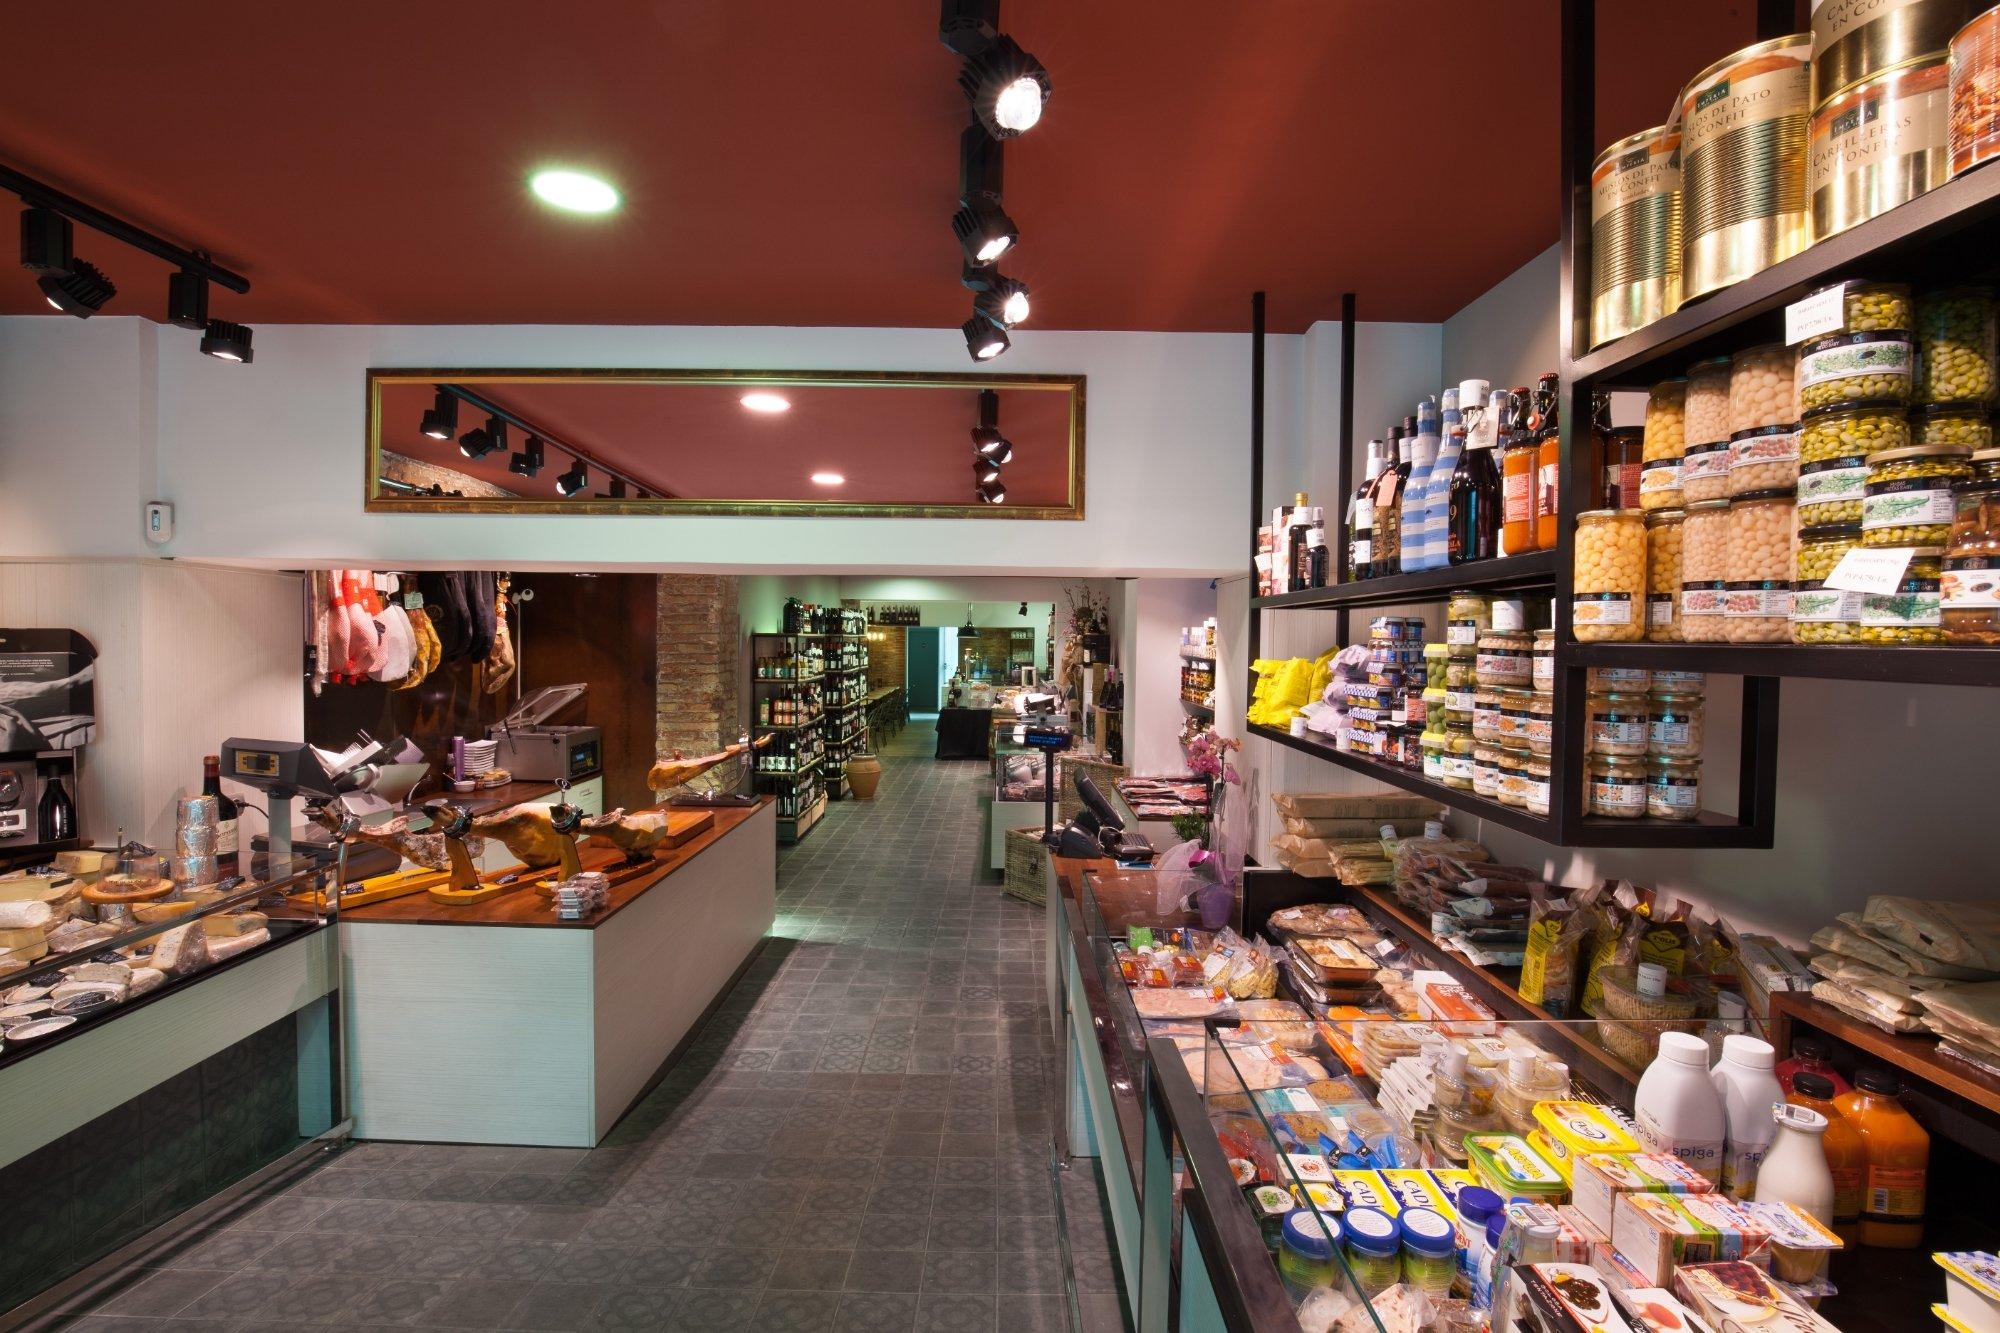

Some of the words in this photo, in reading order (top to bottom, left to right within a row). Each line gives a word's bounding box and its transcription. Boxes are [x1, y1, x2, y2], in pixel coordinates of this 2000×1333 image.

[1832, 15, 1847, 32] EN
[1711, 103, 1727, 118] DE
[1732, 88, 1771, 108] PATO
[1697, 109, 1747, 137] CONFIT
[1833, 109, 1874, 134] IMPERA
[1599, 173, 1630, 197] MUSOS
[1620, 173, 1662, 193] CONFIT
[1672, 1145, 1714, 1160] spiga
